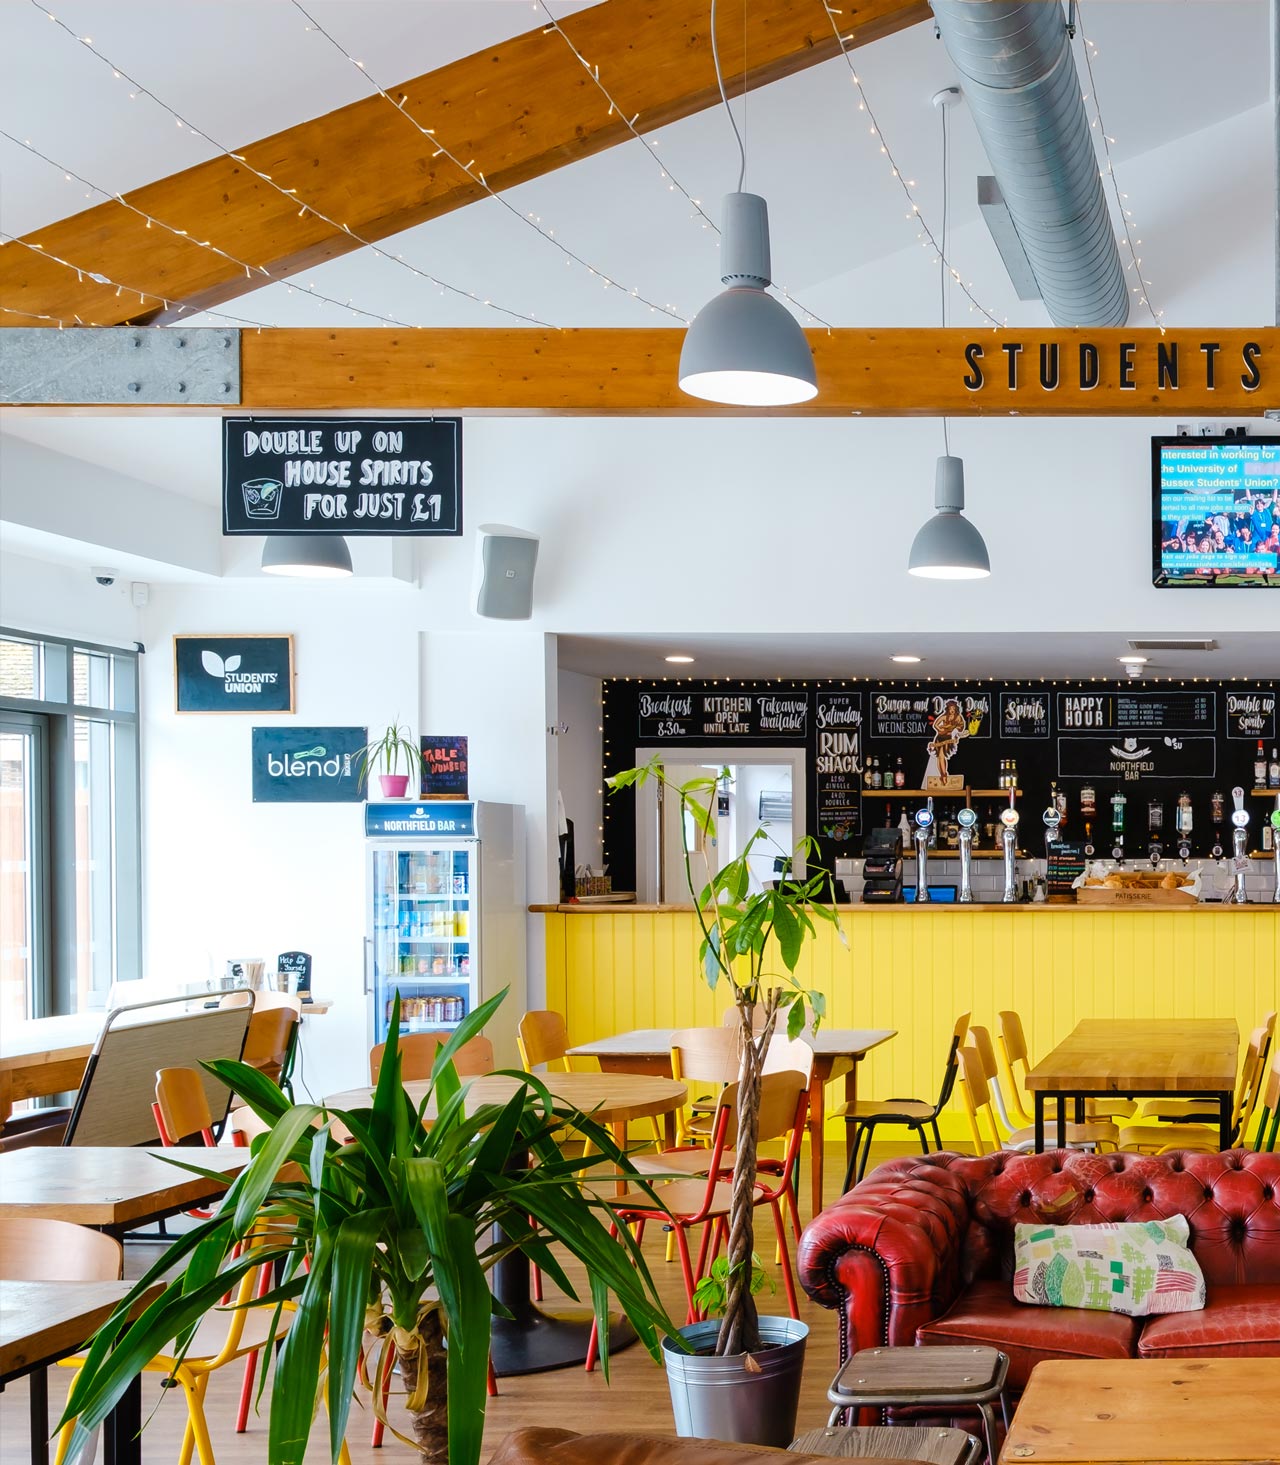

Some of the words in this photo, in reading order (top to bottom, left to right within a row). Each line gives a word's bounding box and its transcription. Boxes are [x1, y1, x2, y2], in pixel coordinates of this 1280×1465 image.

[963, 342, 1262, 391] STUDENTS
[243, 430, 323, 457] DOUBLE
[334, 431, 362, 454] UP
[372, 431, 403, 453] ON
[1161, 450, 1207, 459] nterested
[1210, 450, 1219, 459] in
[1221, 450, 1259, 461] working
[1262, 450, 1275, 459] for
[284, 460, 351, 488] HOUSE
[359, 459, 433, 486] SPIRITS
[1177, 464, 1225, 475] University
[1227, 464, 1238, 473] of
[1161, 479, 1194, 487] Sussex
[1197, 479, 1242, 487] Students'
[1244, 479, 1279, 487] Union?
[303, 494, 348, 520] FOR
[353, 493, 405, 520] JUST
[410, 493, 442, 522] £1
[225, 673, 278, 683] STUDENTS'
[224, 683, 262, 693] UNION
[640, 695, 692, 718] Breakfast
[704, 697, 752, 712] KITCHEN
[757, 697, 808, 717] Takeaway
[876, 695, 911, 714] Burger
[913, 697, 929, 712] and
[1004, 701, 1046, 720] Spirits
[1065, 697, 1104, 711] HAPPY
[1228, 696, 1261, 713] Double
[1262, 698, 1275, 714] up
[715, 712, 739, 723] OPEN
[760, 714, 803, 731] available
[816, 704, 863, 729] Saturday
[1065, 711, 1103, 726] HOUR
[1238, 715, 1265, 730] Spirits
[703, 723, 726, 733] UNTIL
[729, 723, 750, 733] LATE
[878, 721, 927, 734] WEDNESDAY
[820, 732, 858, 757] RUM
[1173, 742, 1183, 750] SU
[423, 748, 458, 763] TABLE
[267, 752, 340, 777] blend
[431, 761, 467, 774] NUMBER
[817, 755, 864, 774] SHACK
[1110, 762, 1154, 771] NORTHFIELD
[1124, 770, 1139, 780] BAR
[384, 820, 435, 831] NORTHFIELD
[437, 820, 456, 831] BAR
[1115, 892, 1152, 900] PATISSERIE
[280, 956, 294, 965] Help
[284, 963, 306, 973] Yourself
